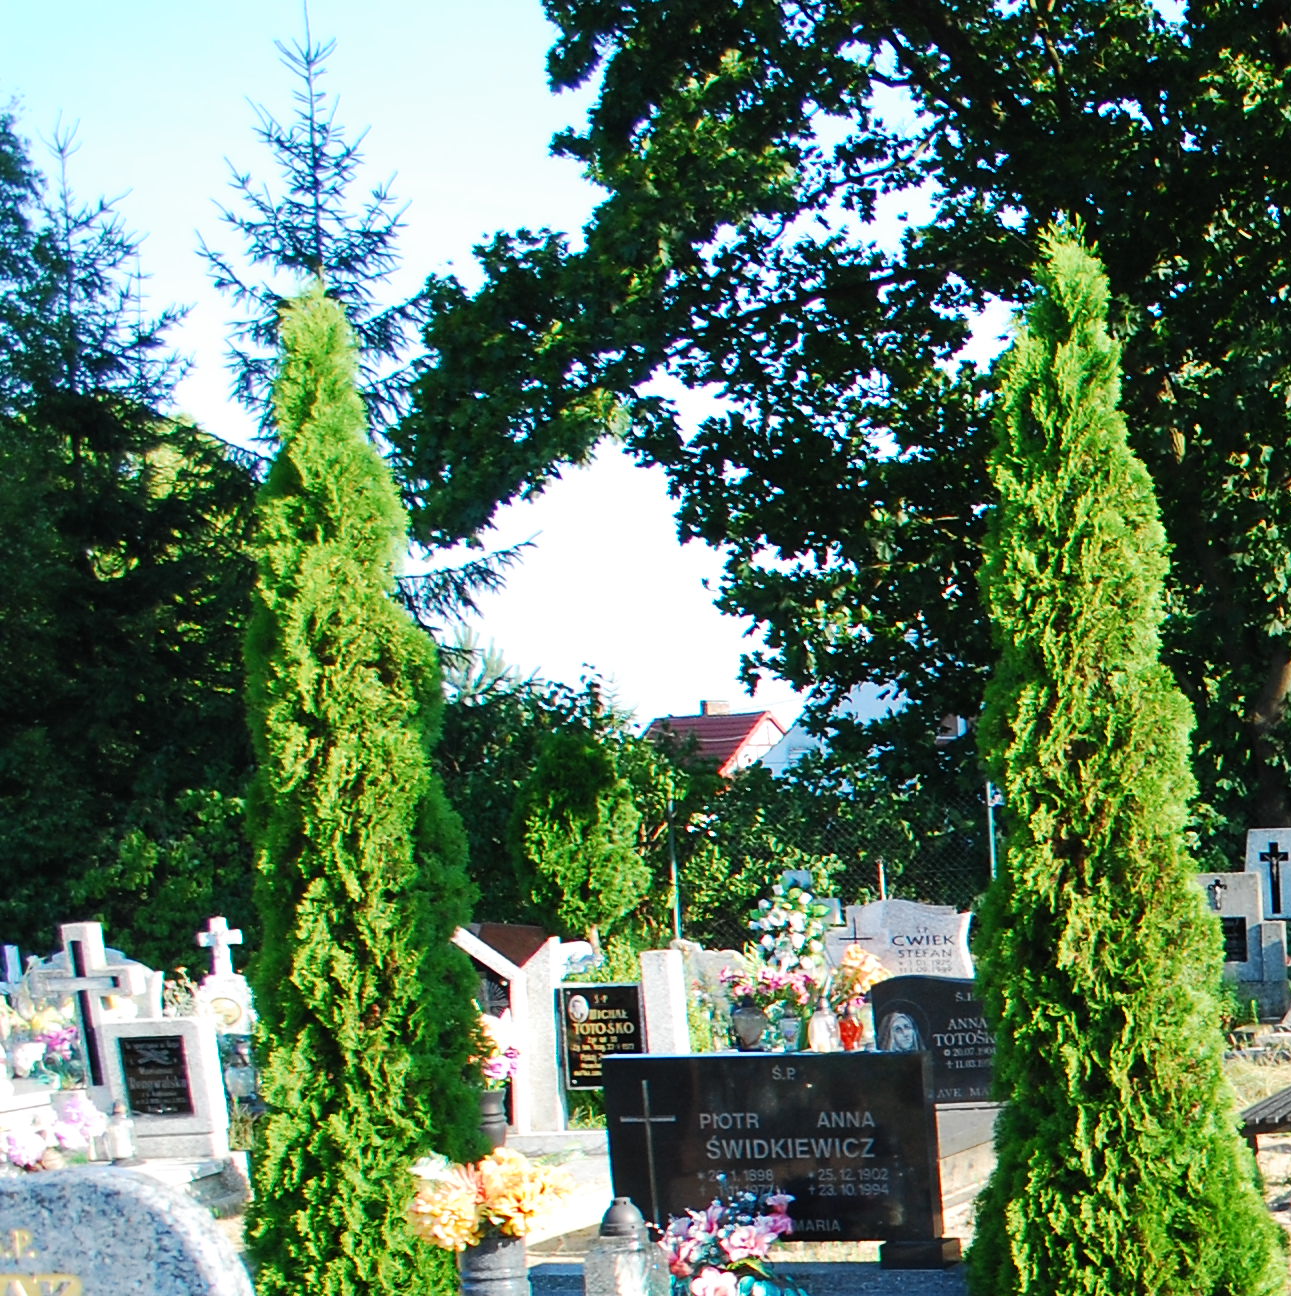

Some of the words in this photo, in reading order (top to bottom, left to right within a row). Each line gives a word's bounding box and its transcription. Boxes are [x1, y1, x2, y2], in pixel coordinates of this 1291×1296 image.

[947, 1017, 988, 1030] ANNA
[699, 1112, 760, 1130] PIOTR
[816, 1111, 876, 1128] ANNA
[705, 1135, 876, 1160] ŚWIDKIEWICZ
